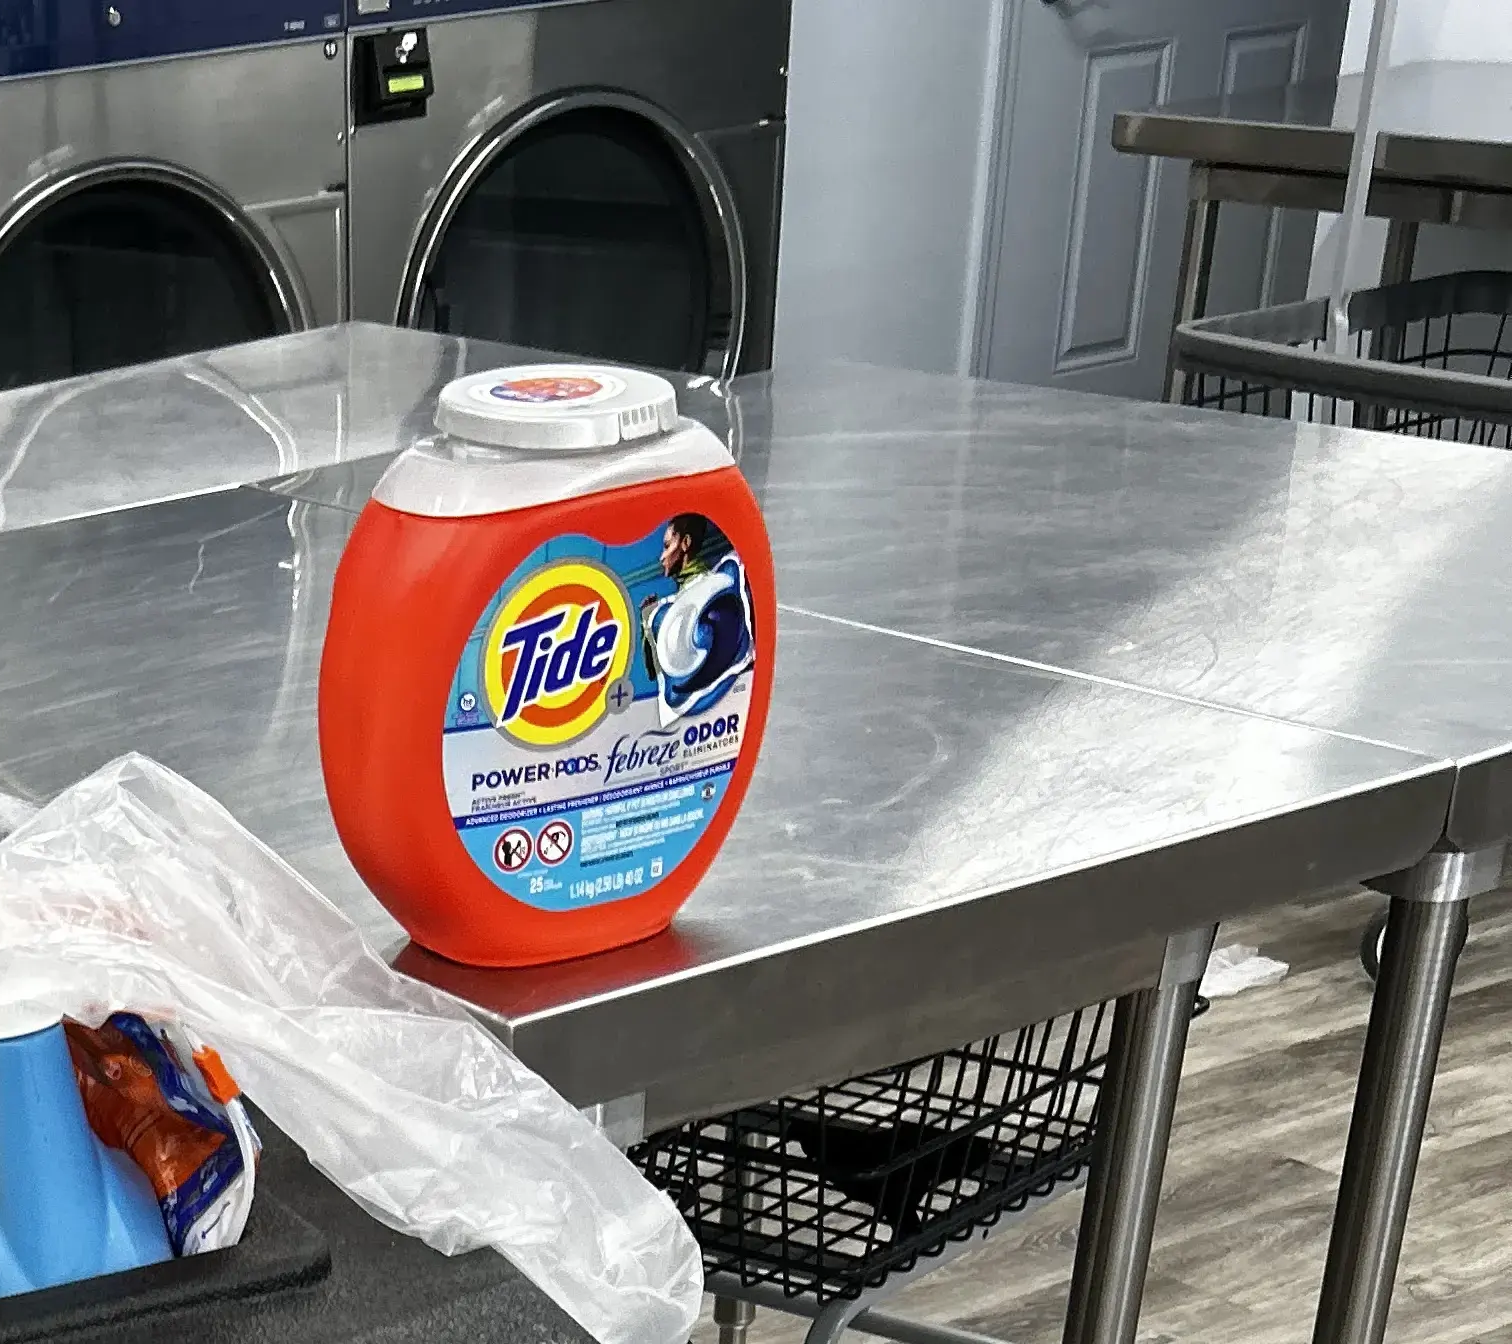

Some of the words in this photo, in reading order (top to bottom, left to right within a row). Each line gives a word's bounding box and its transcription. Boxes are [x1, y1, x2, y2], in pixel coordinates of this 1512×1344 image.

[500, 605, 619, 723] Tide
[683, 714, 740, 747] ODOR
[603, 733, 681, 784] febreze
[682, 734, 740, 758] ELIMINATORS
[471, 764, 550, 792] POWER
[529, 877, 544, 894] 25
